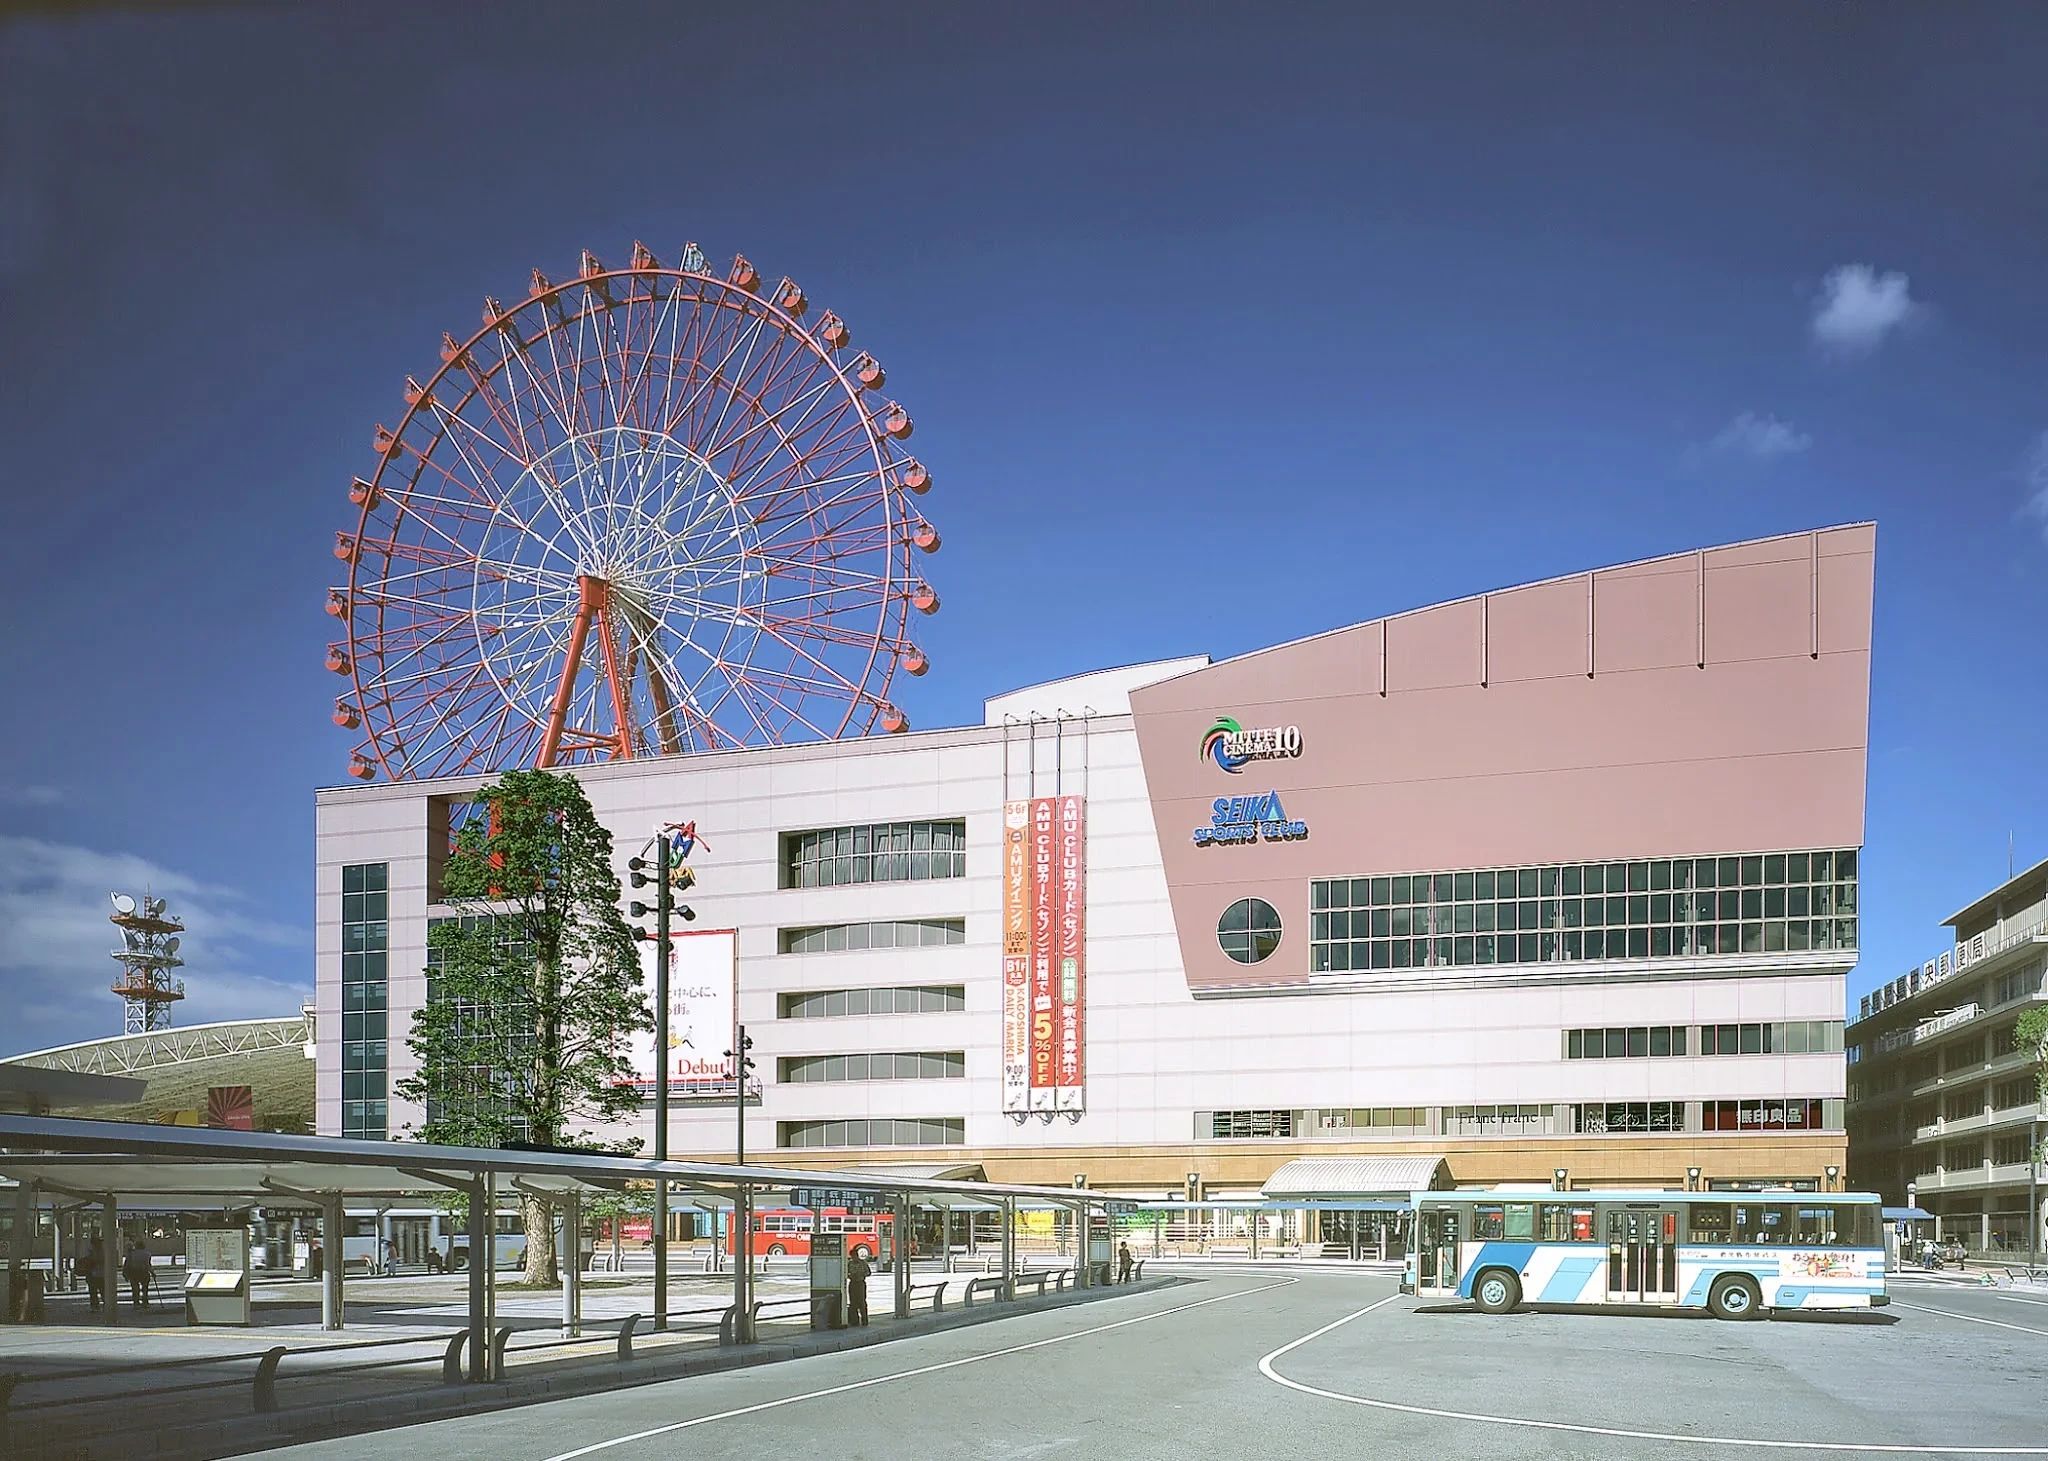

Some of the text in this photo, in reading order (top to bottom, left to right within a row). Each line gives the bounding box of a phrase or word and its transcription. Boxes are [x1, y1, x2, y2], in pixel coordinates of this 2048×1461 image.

[1223, 741, 1272, 756] CINEMA
[1272, 725, 1300, 752] 10
[1035, 801, 1051, 832] AMU
[1062, 798, 1078, 832] AMU
[1211, 789, 1287, 824] SEIKA
[1195, 822, 1306, 842] SPORTS CLUB
[1005, 988, 1015, 1063] DAILY MARKET
[1016, 988, 1026, 1056] KAGOSHIMA
[678, 1058, 731, 1076] Debut!
[1502, 1111, 1538, 1123] franc
[1737, 1108, 1802, 1124] 無印良品
